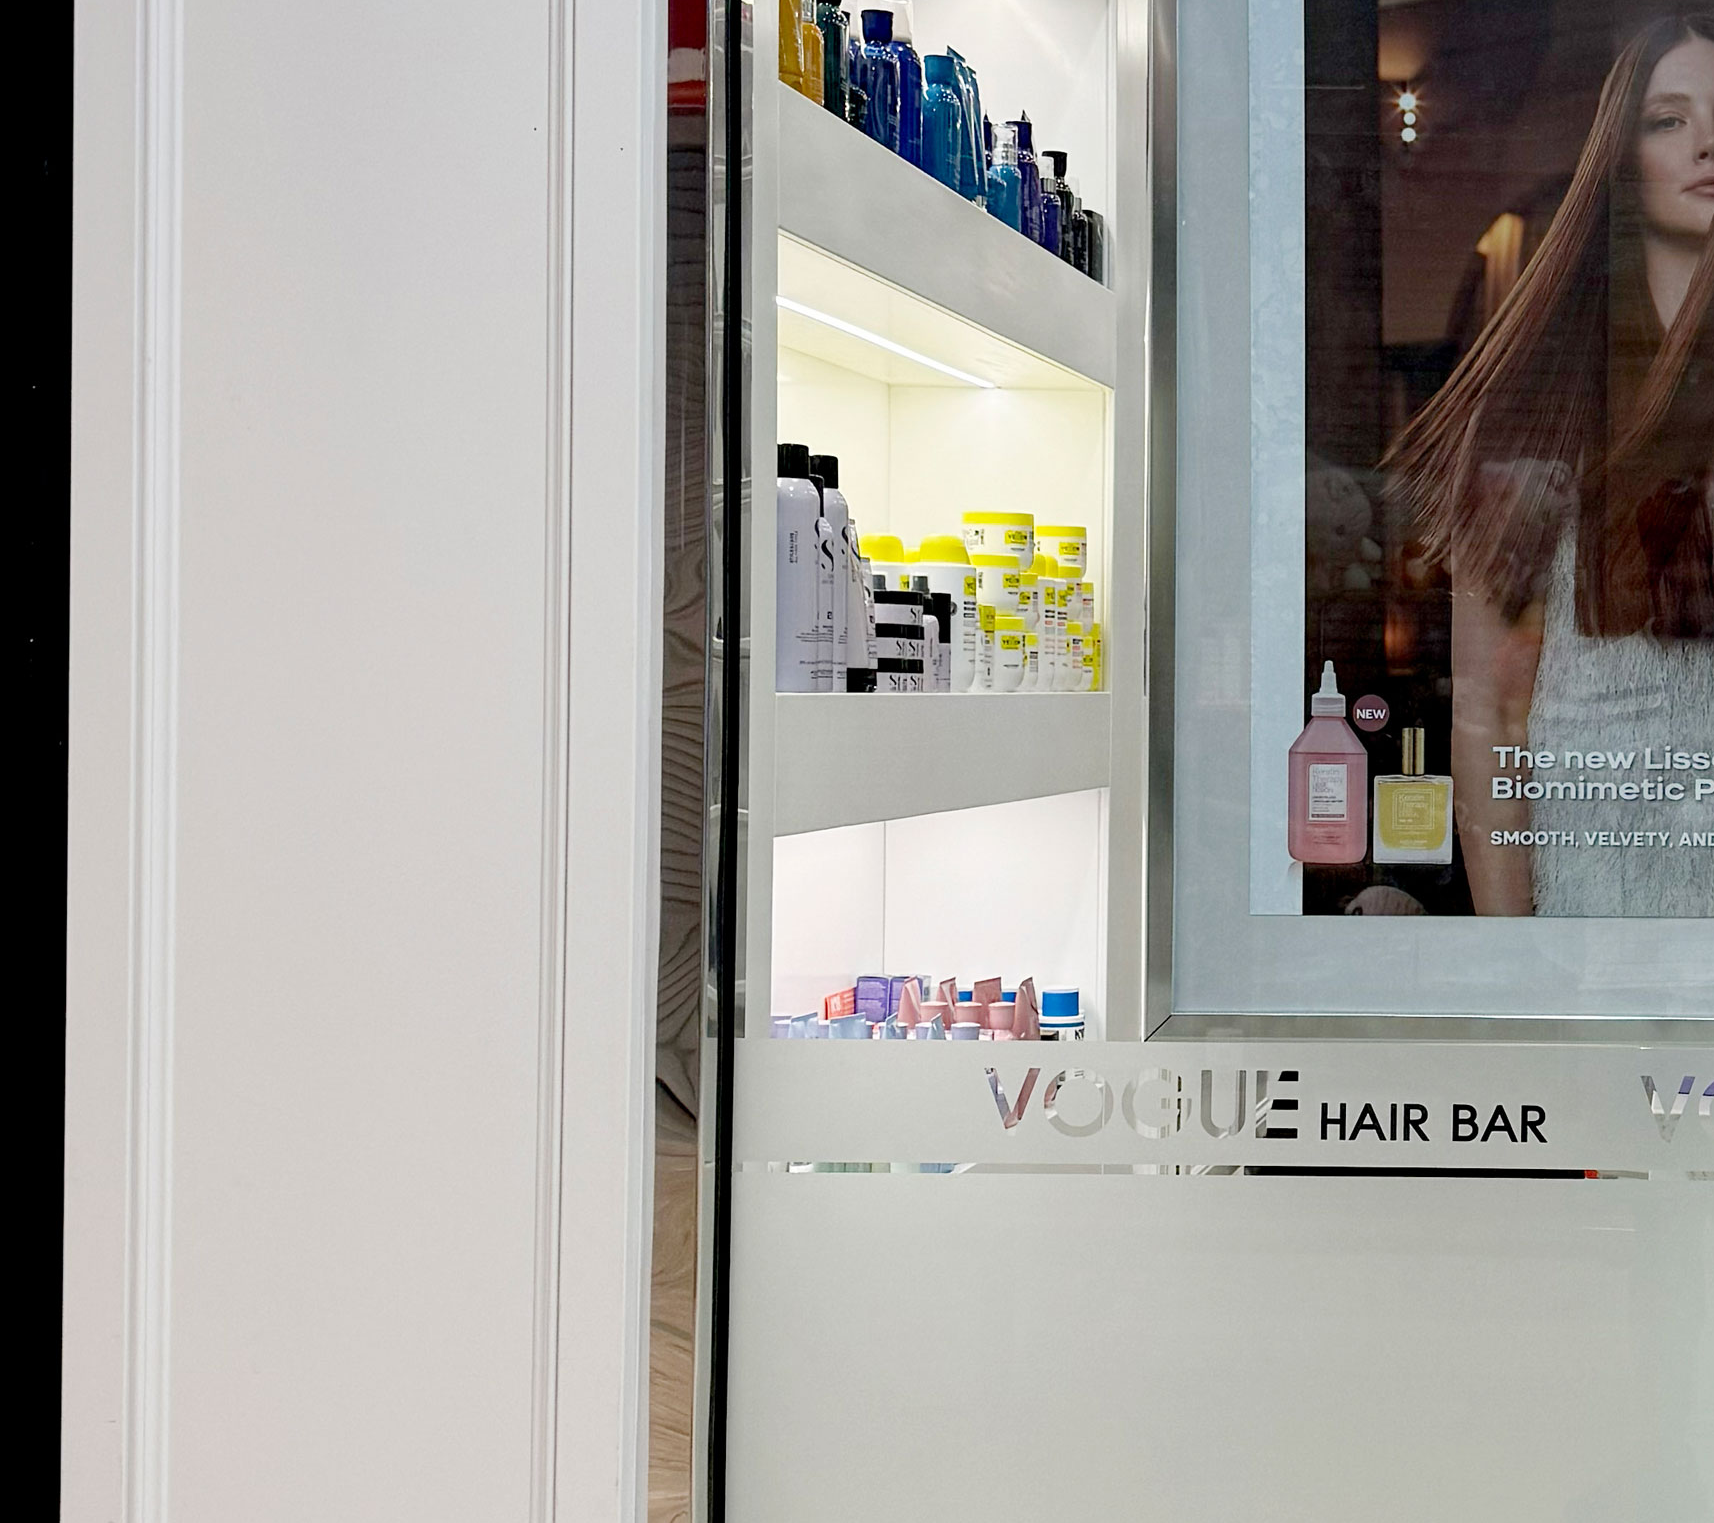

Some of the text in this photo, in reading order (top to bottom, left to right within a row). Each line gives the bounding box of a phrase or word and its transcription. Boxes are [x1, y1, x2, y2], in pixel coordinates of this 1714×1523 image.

[1356, 707, 1386, 720] NEW
[1492, 746, 1557, 770] The
[1564, 750, 1637, 770] new
[1490, 776, 1686, 801] Biomimetic
[1489, 831, 1580, 848] SMOOTH,
[1584, 831, 1675, 849] VELVETY,
[984, 1067, 1548, 1144] VOGUE HAIR BAR
